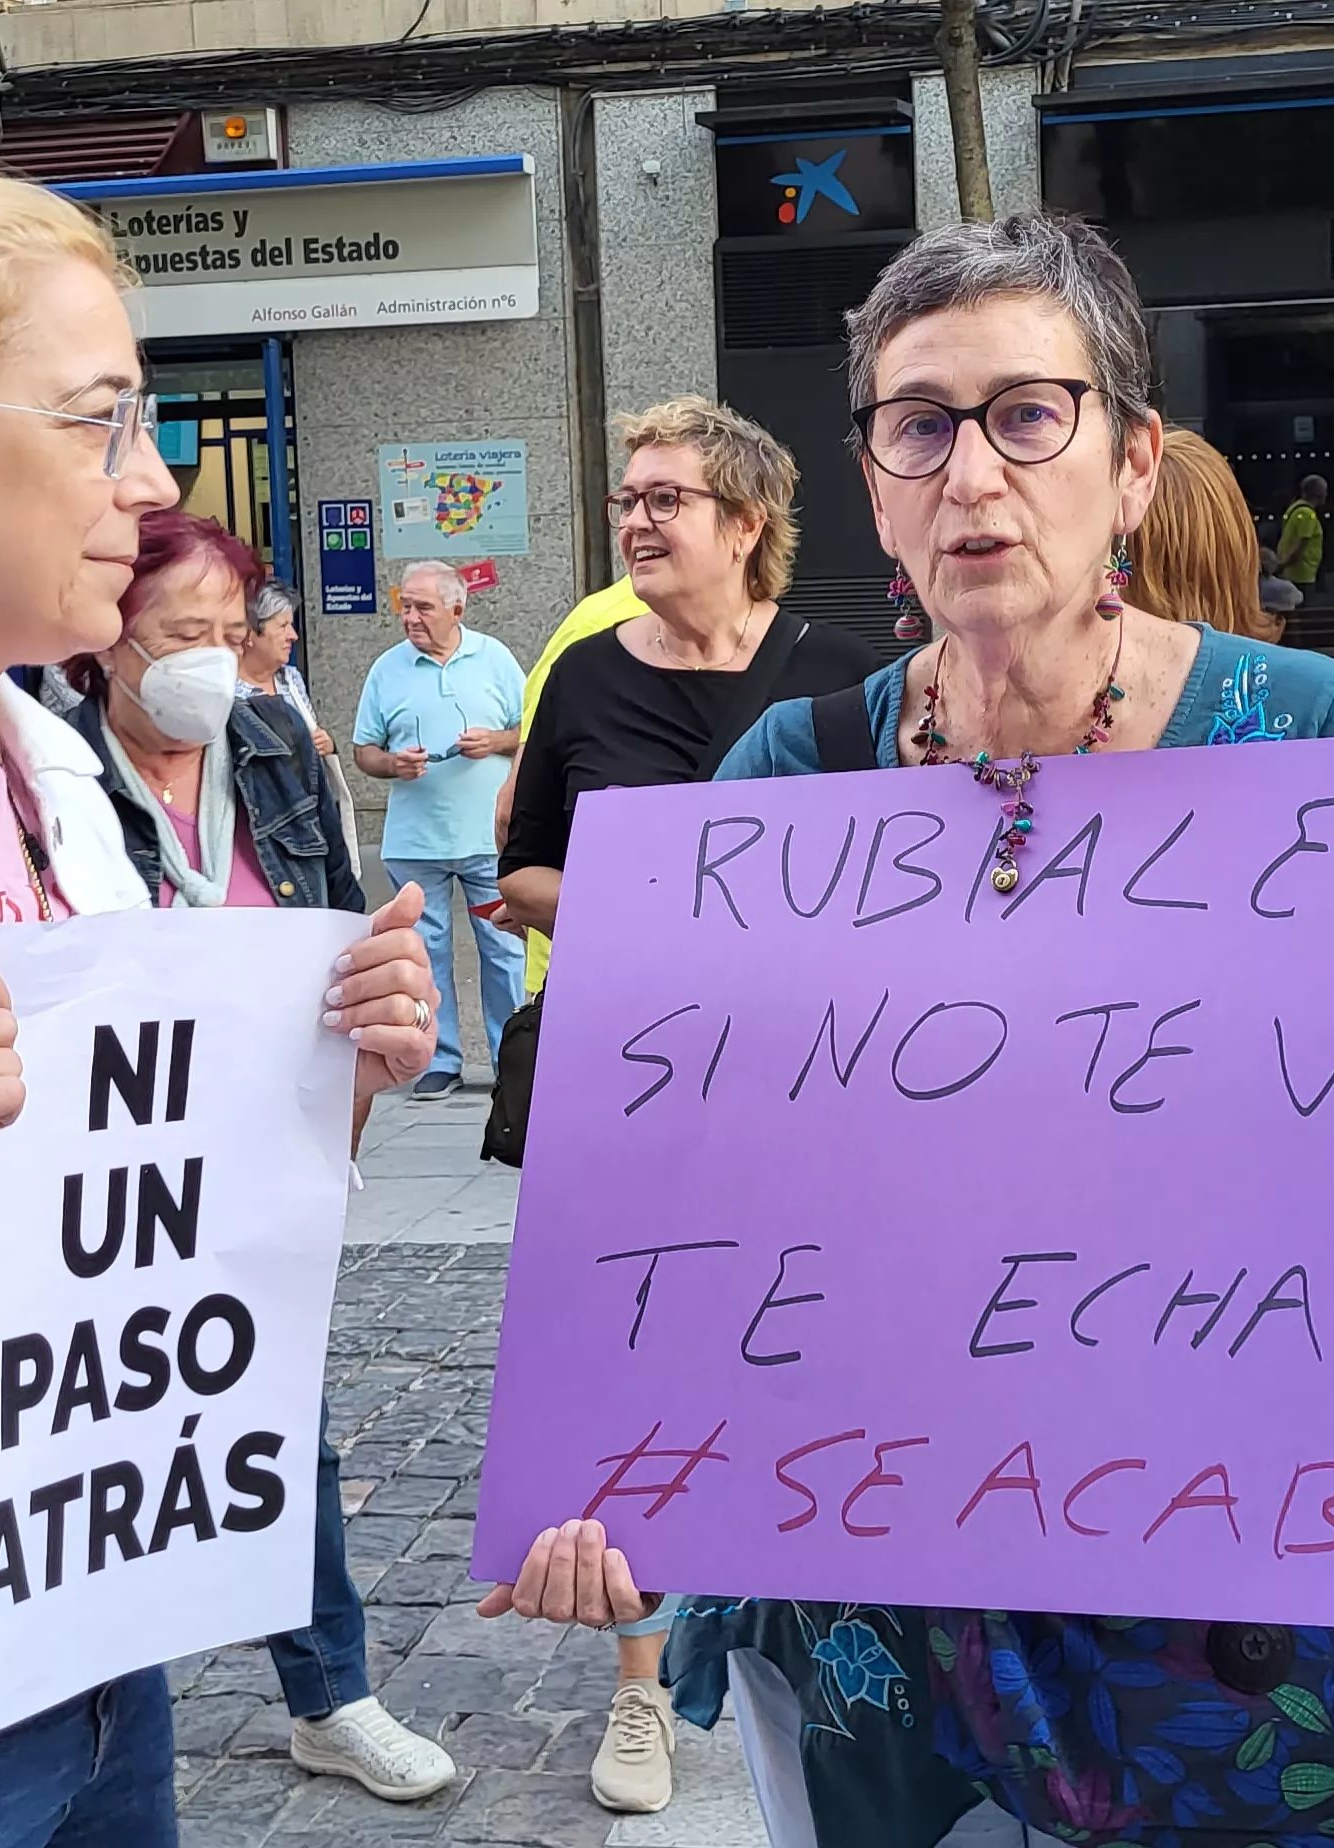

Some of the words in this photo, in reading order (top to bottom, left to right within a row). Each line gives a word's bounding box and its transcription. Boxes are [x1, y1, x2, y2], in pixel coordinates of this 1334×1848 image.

[110, 205, 224, 237] Loterías
[233, 210, 249, 233] y
[251, 238, 293, 267] del
[303, 232, 400, 264] Estado
[252, 304, 307, 322] Alfonso
[311, 302, 358, 319] Gallán
[377, 294, 488, 316] Administración
[88, 1019, 195, 1132] NI
[622, 1003, 730, 1118] SI
[788, 987, 1008, 1102] NO
[1055, 1000, 1201, 1114] TE
[61, 1157, 203, 1279] UN
[596, 1240, 825, 1367] TE
[0, 1293, 255, 1450] PASO
